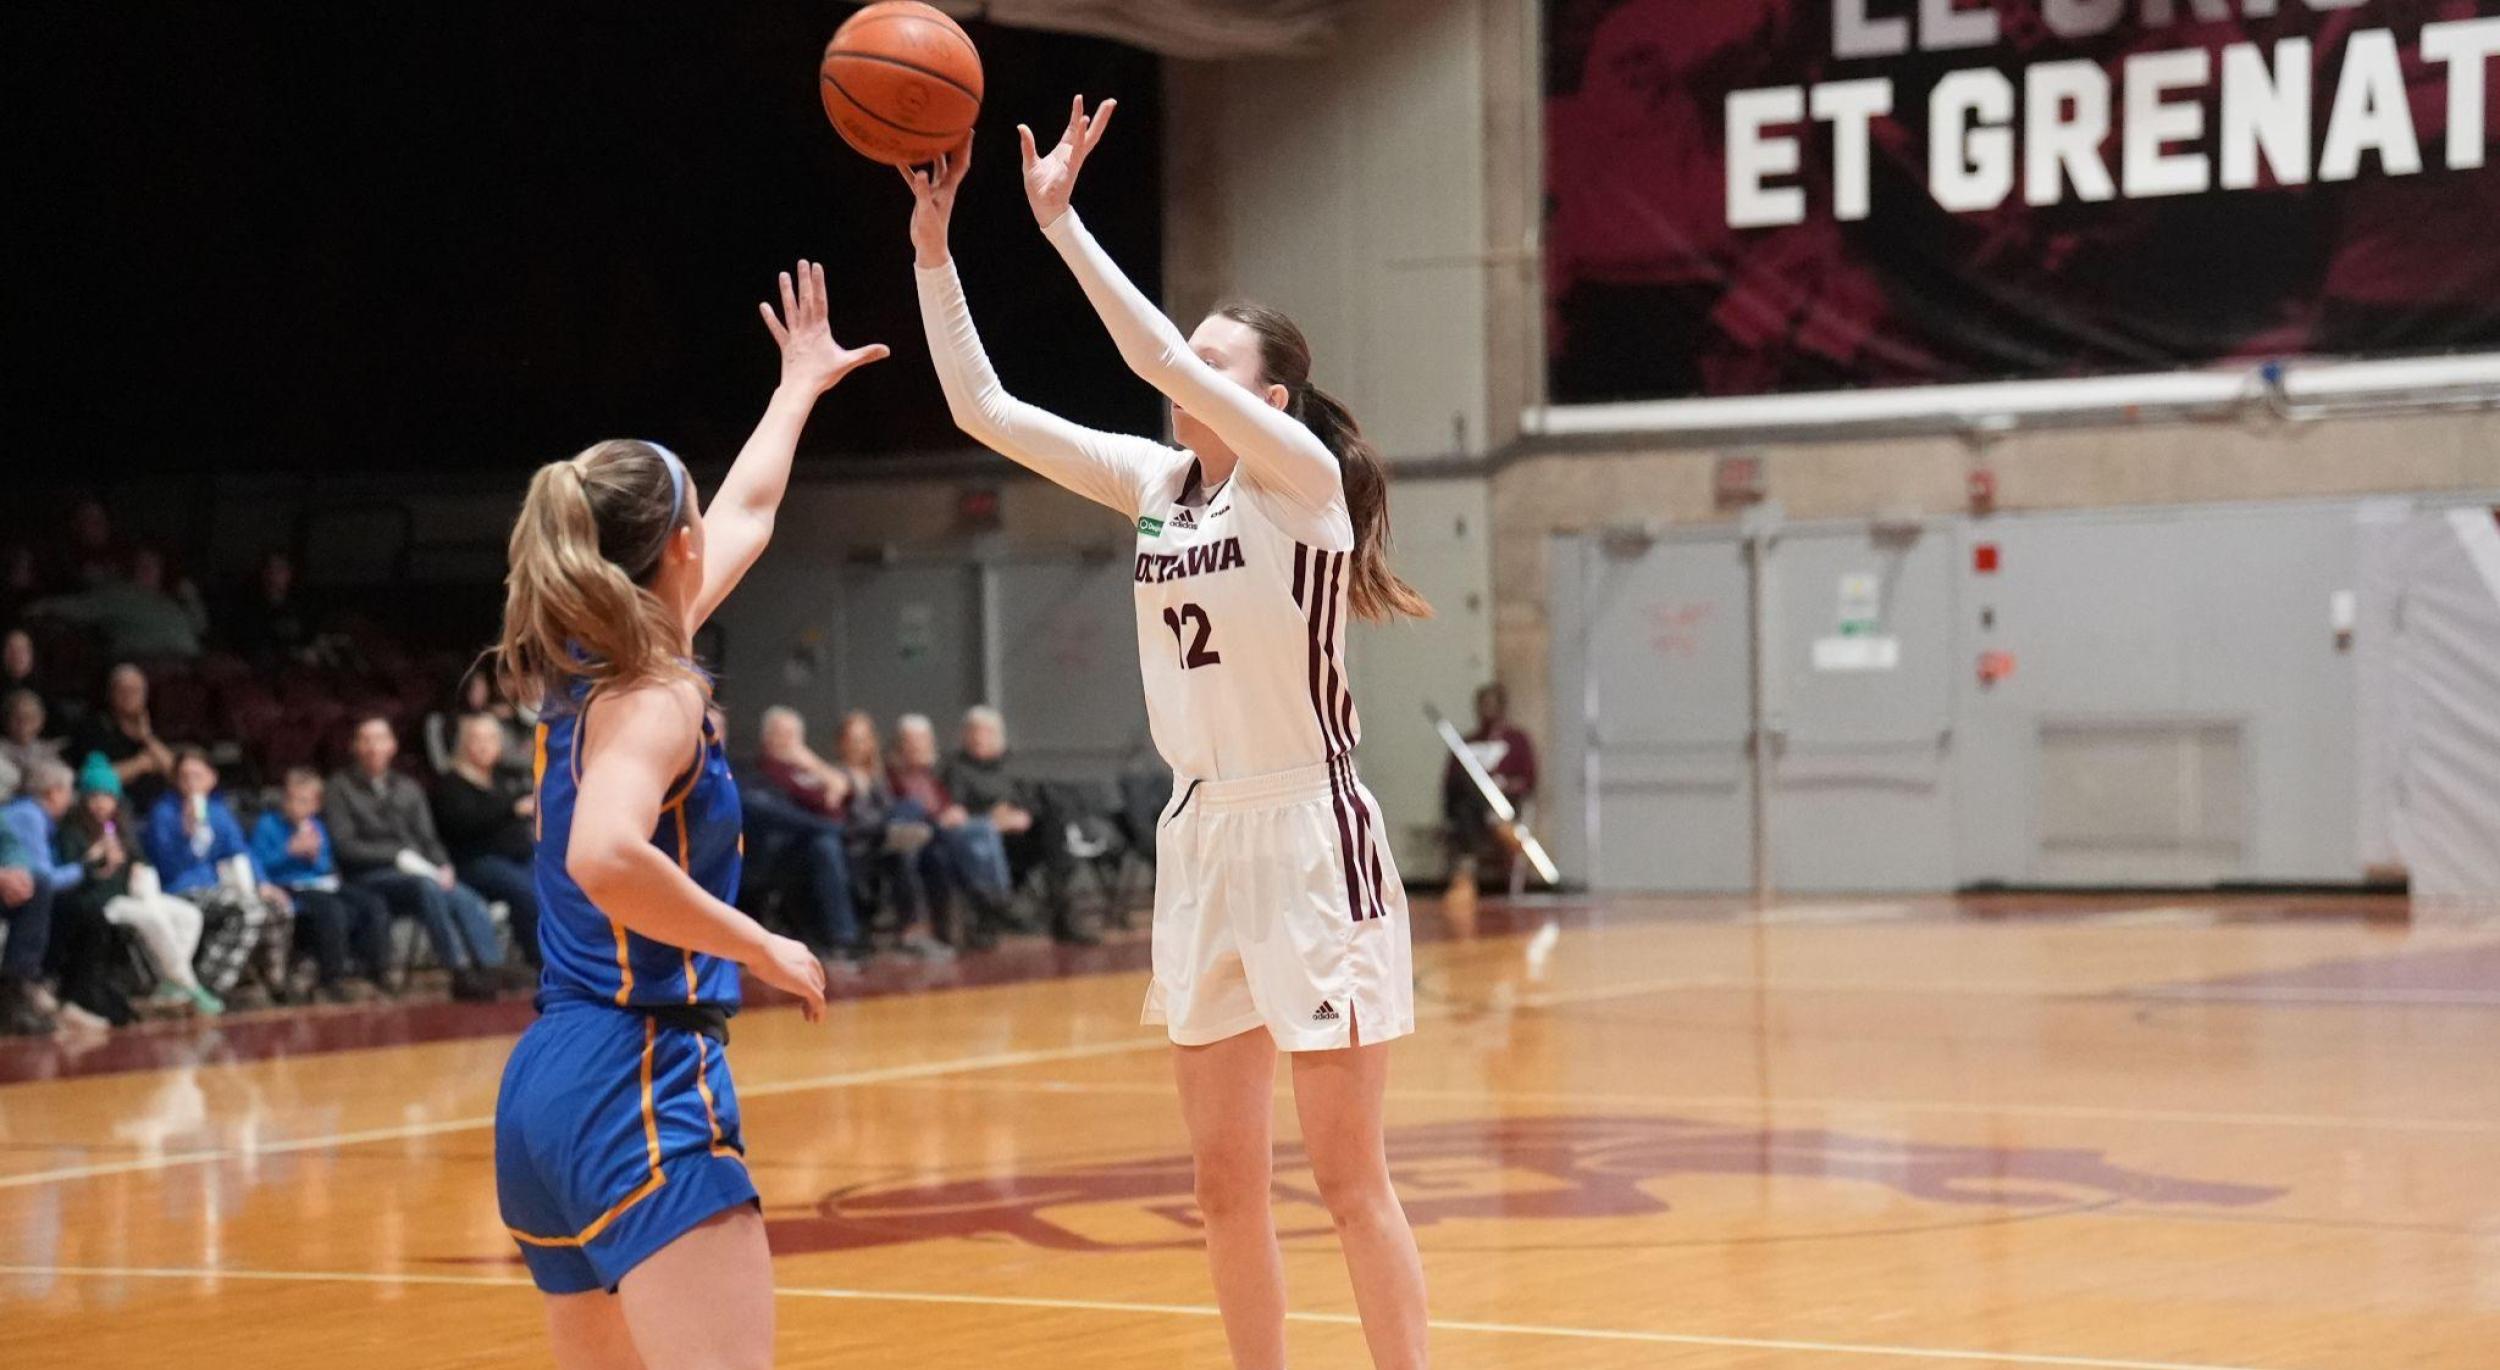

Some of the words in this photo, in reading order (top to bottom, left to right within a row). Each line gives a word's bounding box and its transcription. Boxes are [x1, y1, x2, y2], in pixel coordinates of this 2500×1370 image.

[1725, 76, 1894, 229] ET
[1928, 16, 2500, 213] GRENAT
[1169, 521, 1198, 530] adidas
[1163, 603, 1221, 669] 12
[1312, 1012, 1339, 1020] adidas
